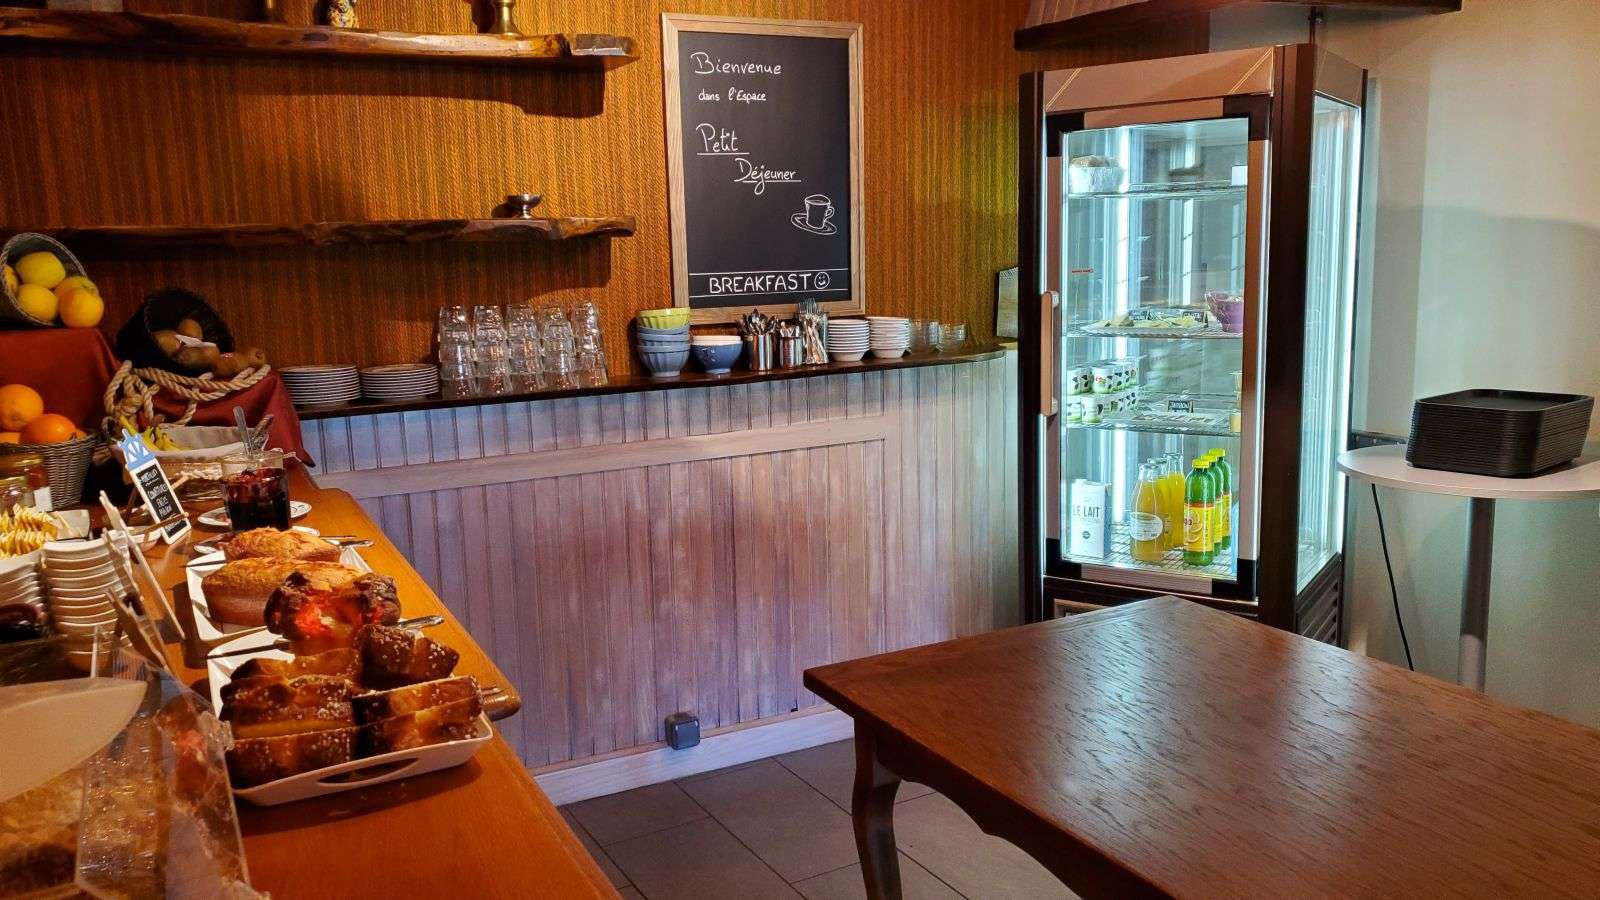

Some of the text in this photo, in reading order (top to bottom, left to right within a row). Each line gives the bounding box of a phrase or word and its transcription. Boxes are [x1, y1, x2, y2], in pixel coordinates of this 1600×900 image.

[691, 52, 782, 74] Bienvenue
[698, 87, 767, 104] dans l'Espace
[696, 123, 738, 153] Petit
[734, 158, 797, 195] Déjeuner
[709, 273, 812, 294] BREAKFAST
[1072, 504, 1100, 518] LE LAIT
